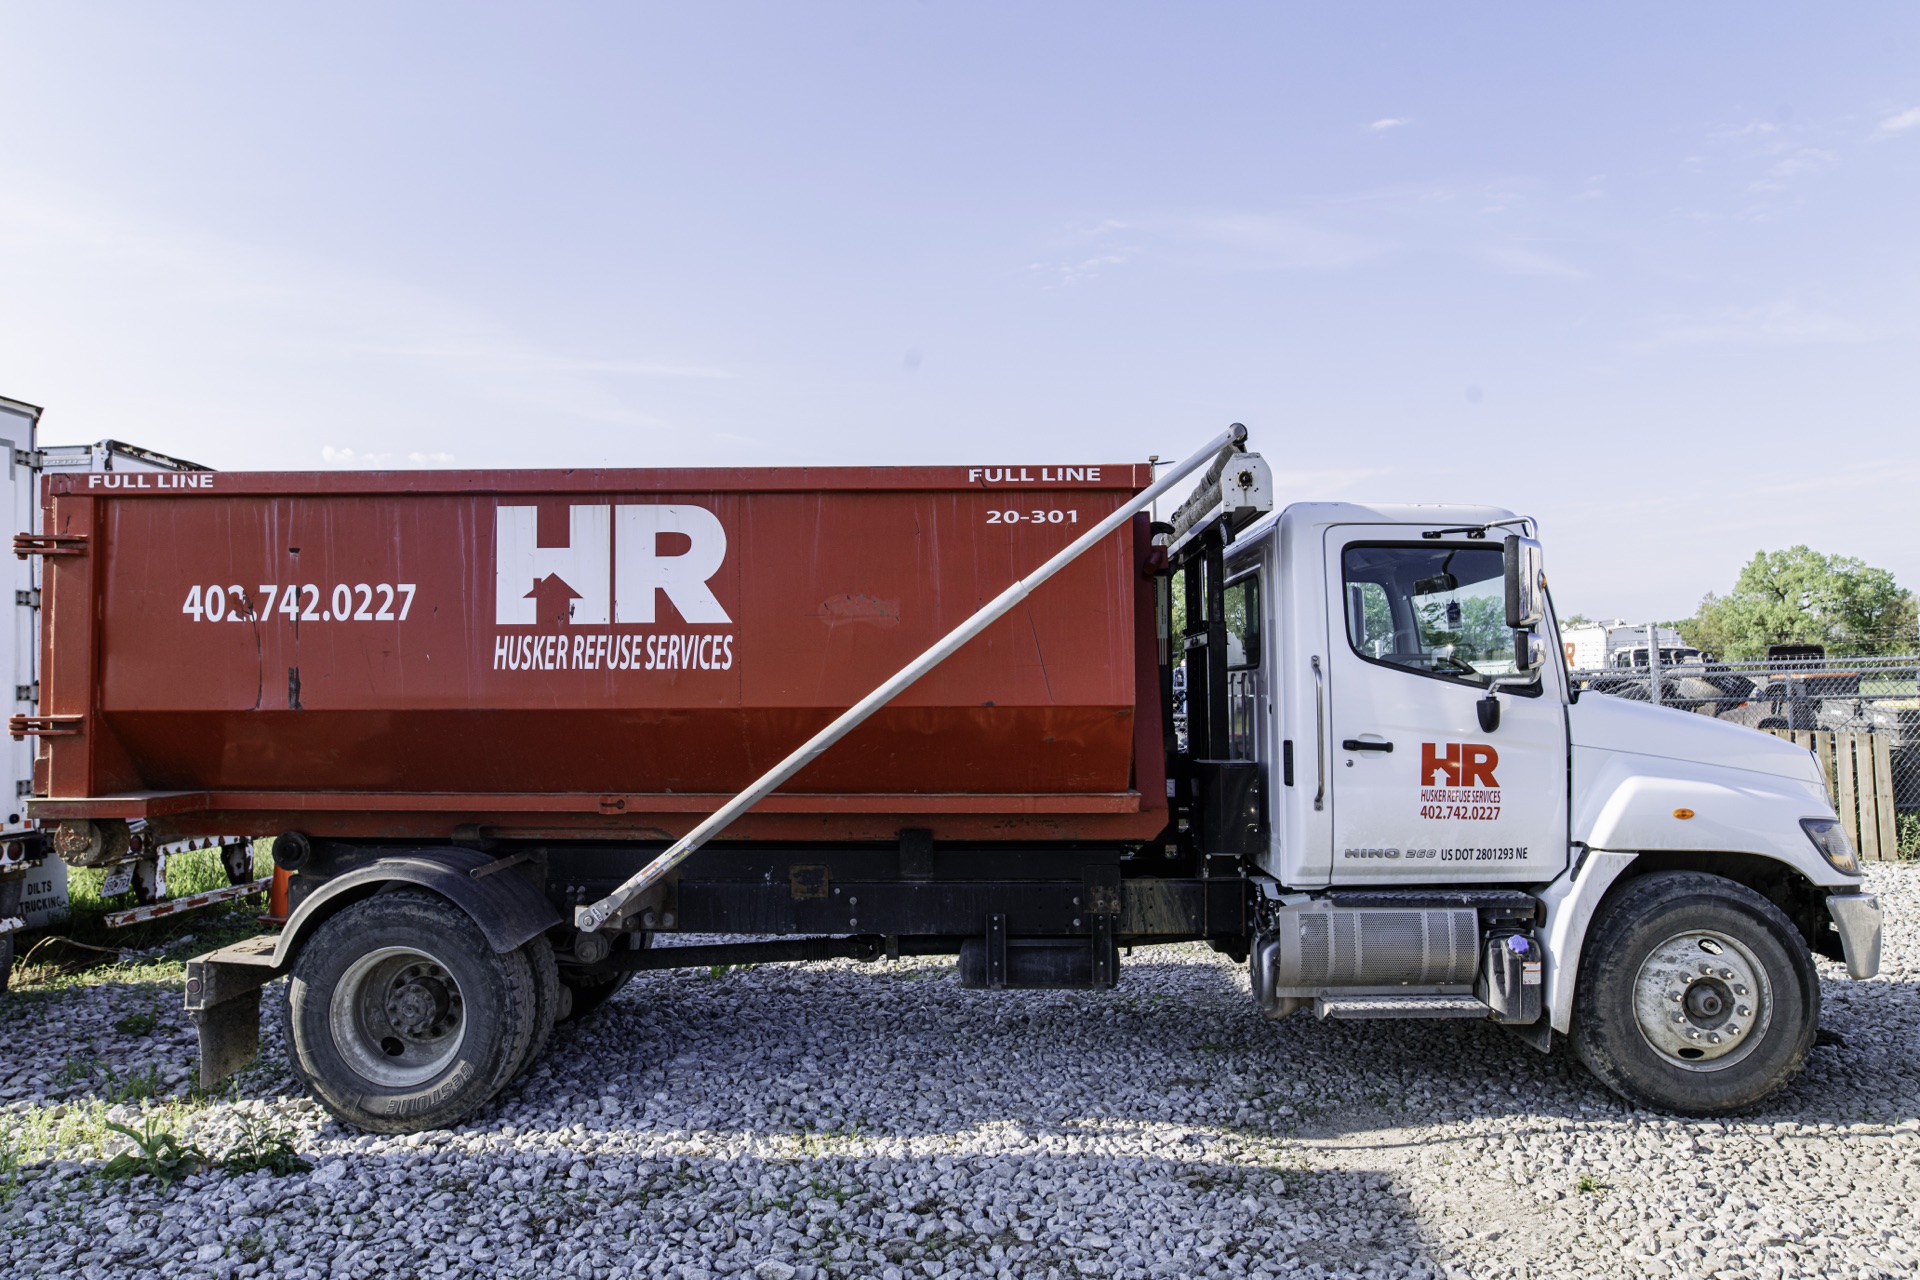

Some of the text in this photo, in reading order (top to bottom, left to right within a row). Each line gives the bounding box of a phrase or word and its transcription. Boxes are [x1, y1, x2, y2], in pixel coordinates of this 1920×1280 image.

[88, 474, 214, 489] FULL LINE
[968, 467, 1101, 483] FULL LINE
[986, 509, 1077, 524] 20-301
[495, 504, 733, 625] HR
[182, 583, 417, 623] 402.742.0227
[493, 634, 734, 670] HUSKER REFUSE SERVICES
[1421, 742, 1500, 788] HR
[1420, 789, 1501, 804] HUSKER REFUSE SERVICES
[1420, 805, 1501, 821] 402.742.0227
[1344, 848, 1437, 859] HINO 268
[1441, 847, 1528, 861] US DOT 2801293 NE
[27, 880, 52, 896] DILTS
[19, 895, 64, 914] TRUCKING
